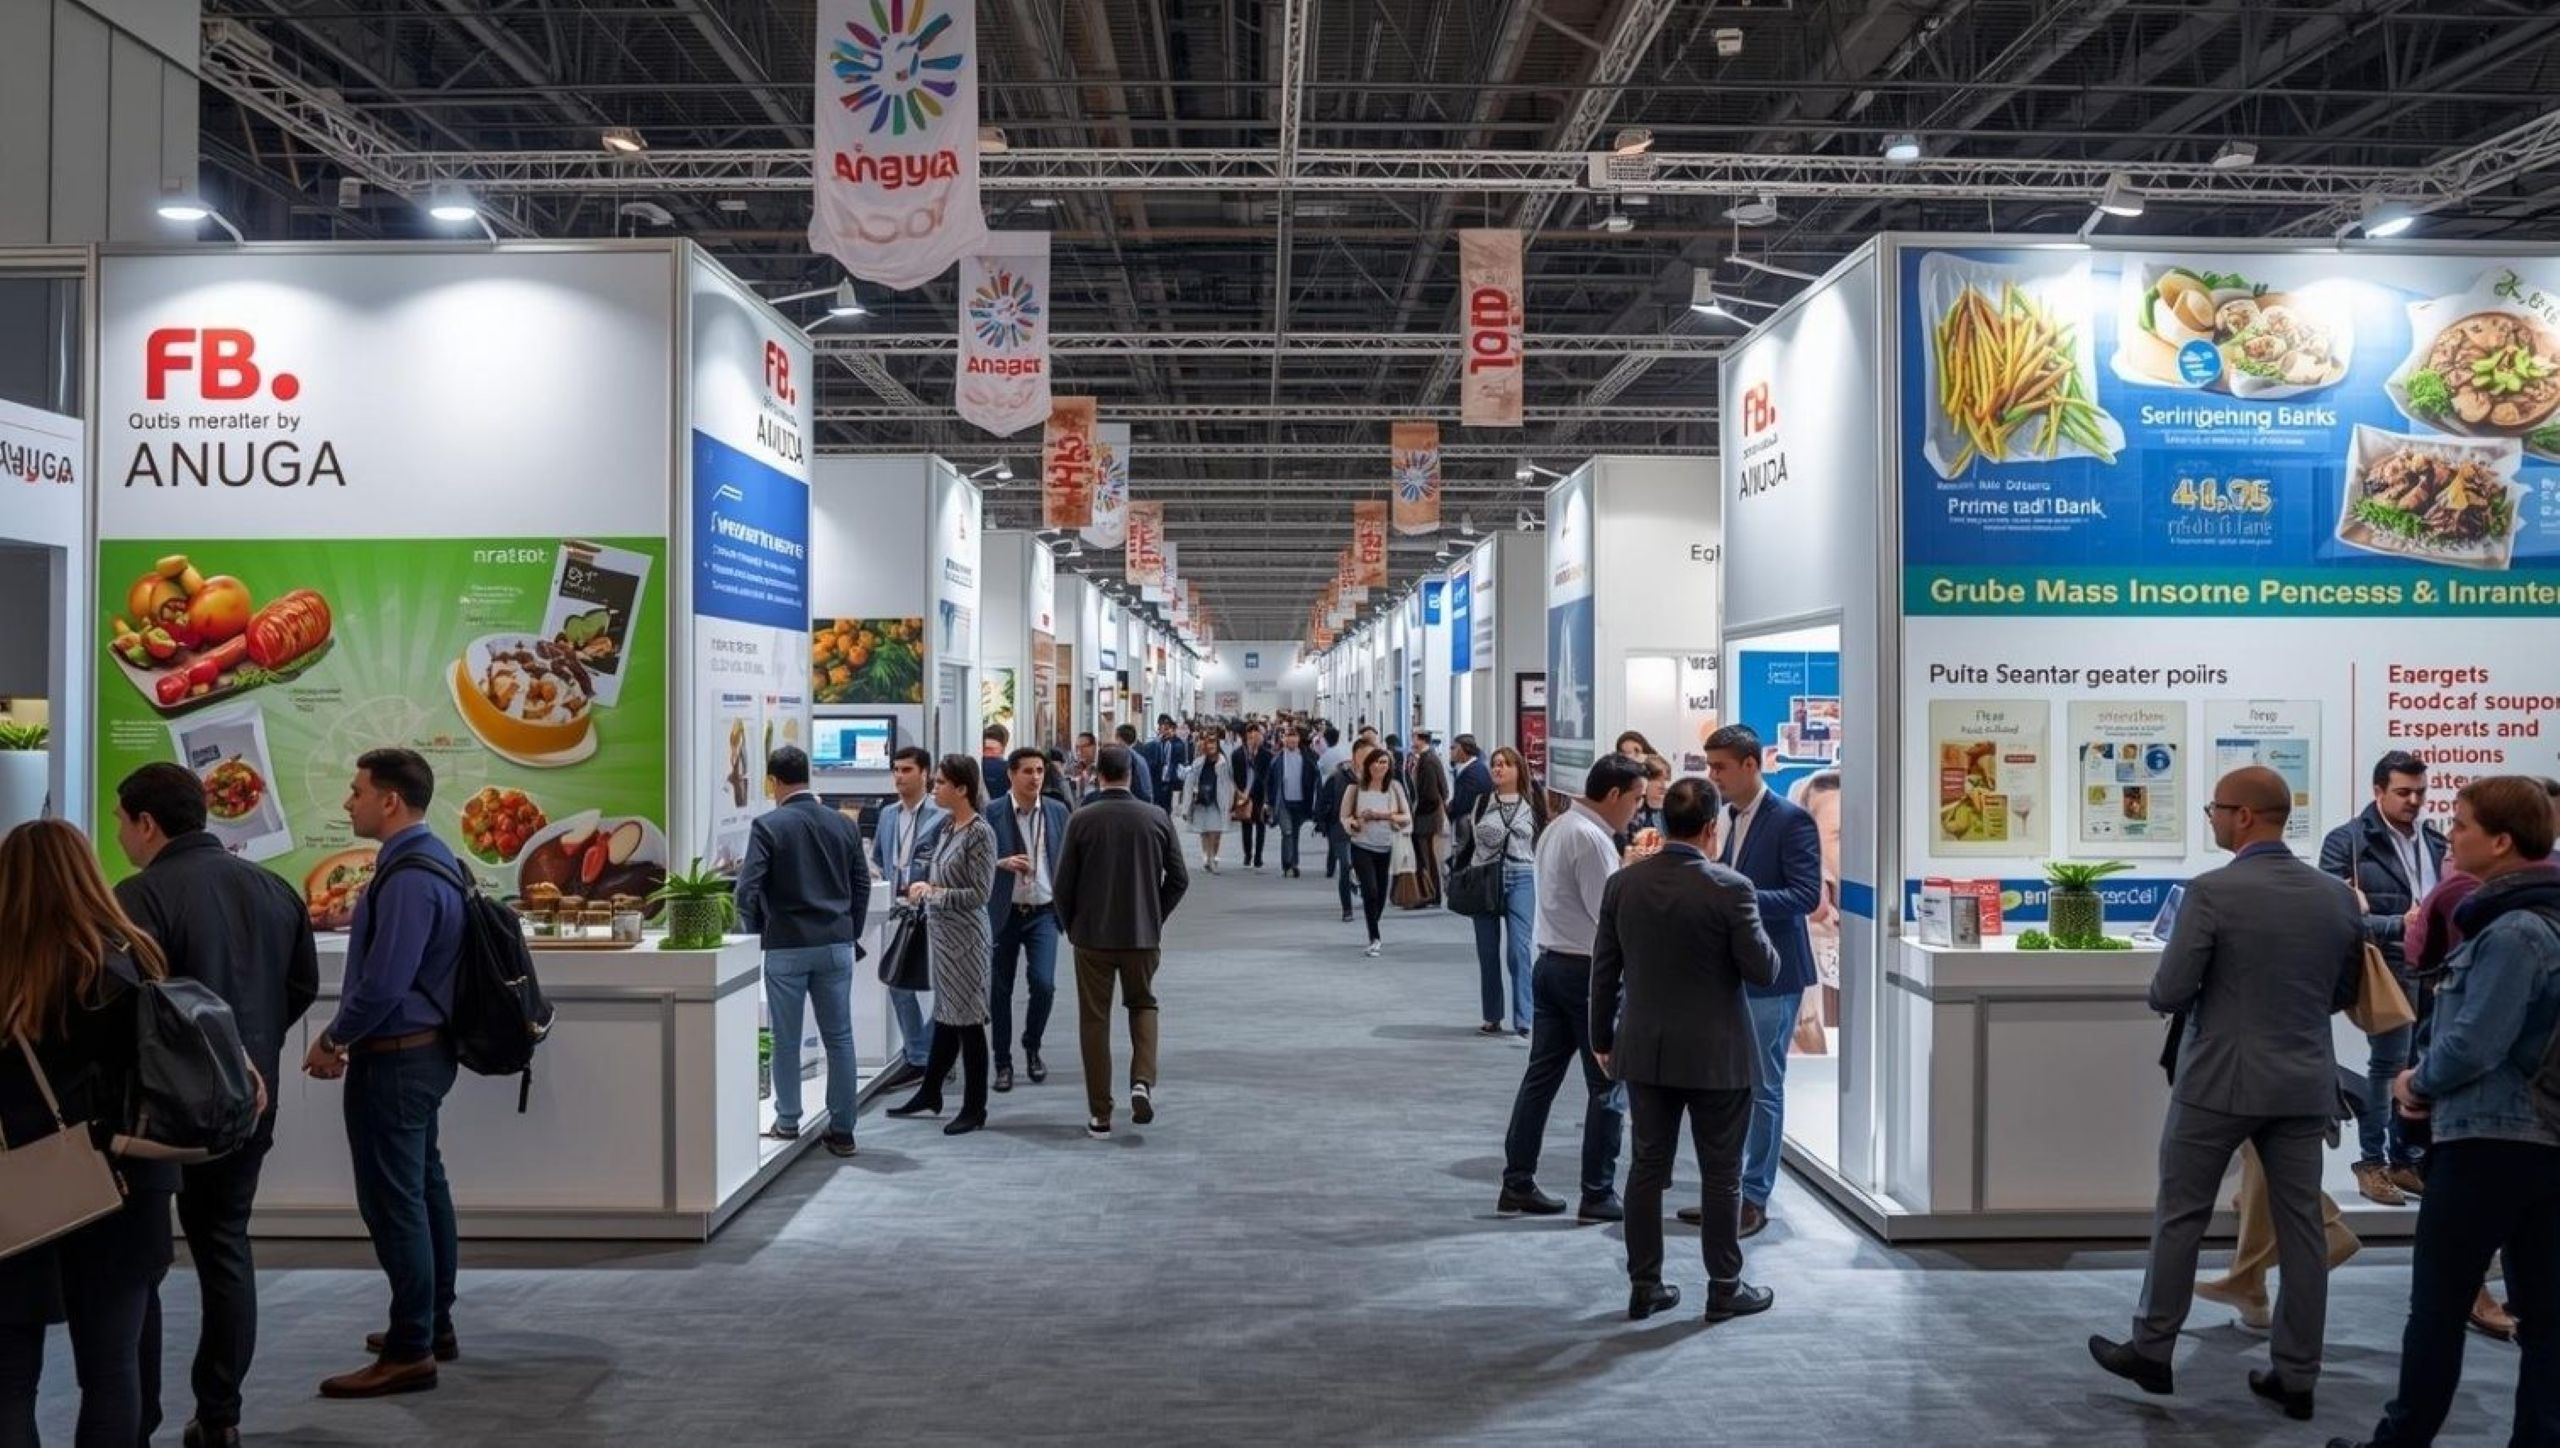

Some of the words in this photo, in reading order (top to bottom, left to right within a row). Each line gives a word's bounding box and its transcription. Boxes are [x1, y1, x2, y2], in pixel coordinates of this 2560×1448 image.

[146, 328, 299, 401] FB.
[277, 412, 301, 433] by
[124, 439, 347, 488] ANUGA
[1930, 578, 2025, 603] Grube
[2036, 579, 2119, 603] Mass
[2260, 579, 2402, 604] Pencesss
[2413, 580, 2439, 604] &
[1996, 664, 2080, 684] Seantar
[2086, 665, 2160, 688] geater
[2497, 719, 2539, 738] and
